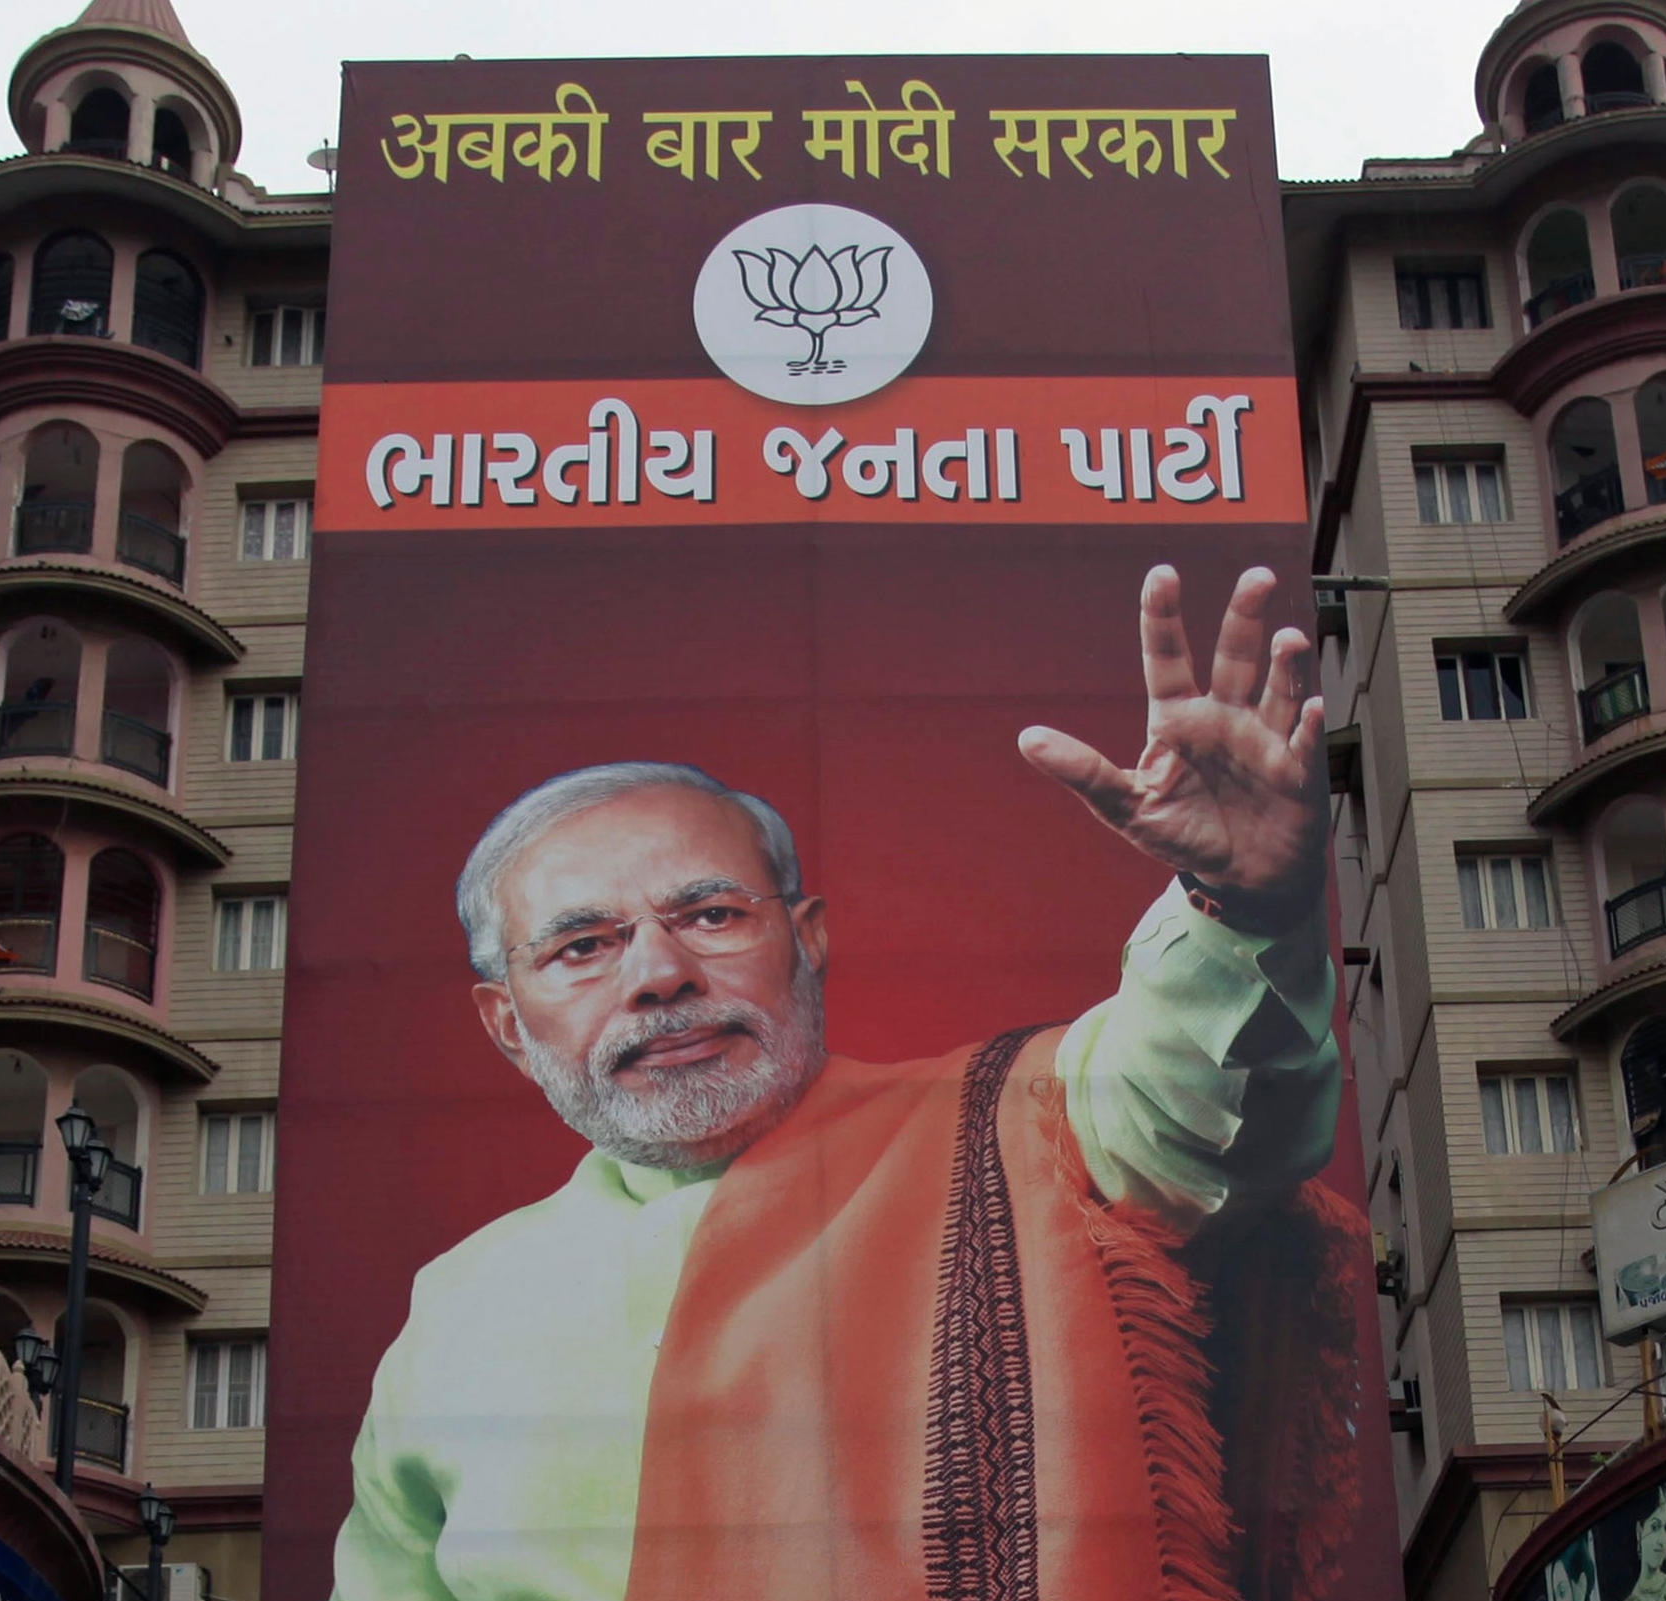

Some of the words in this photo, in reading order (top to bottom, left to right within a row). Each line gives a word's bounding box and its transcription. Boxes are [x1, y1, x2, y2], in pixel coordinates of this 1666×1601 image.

[380, 82, 609, 184] अबकी
[644, 109, 774, 182] बार
[802, 80, 956, 180] मोदी
[990, 107, 1237, 180] सरकार
[363, 396, 716, 510] ભારતીય
[761, 425, 1022, 504] જનતા
[1060, 394, 1254, 504] પાર્ટી
